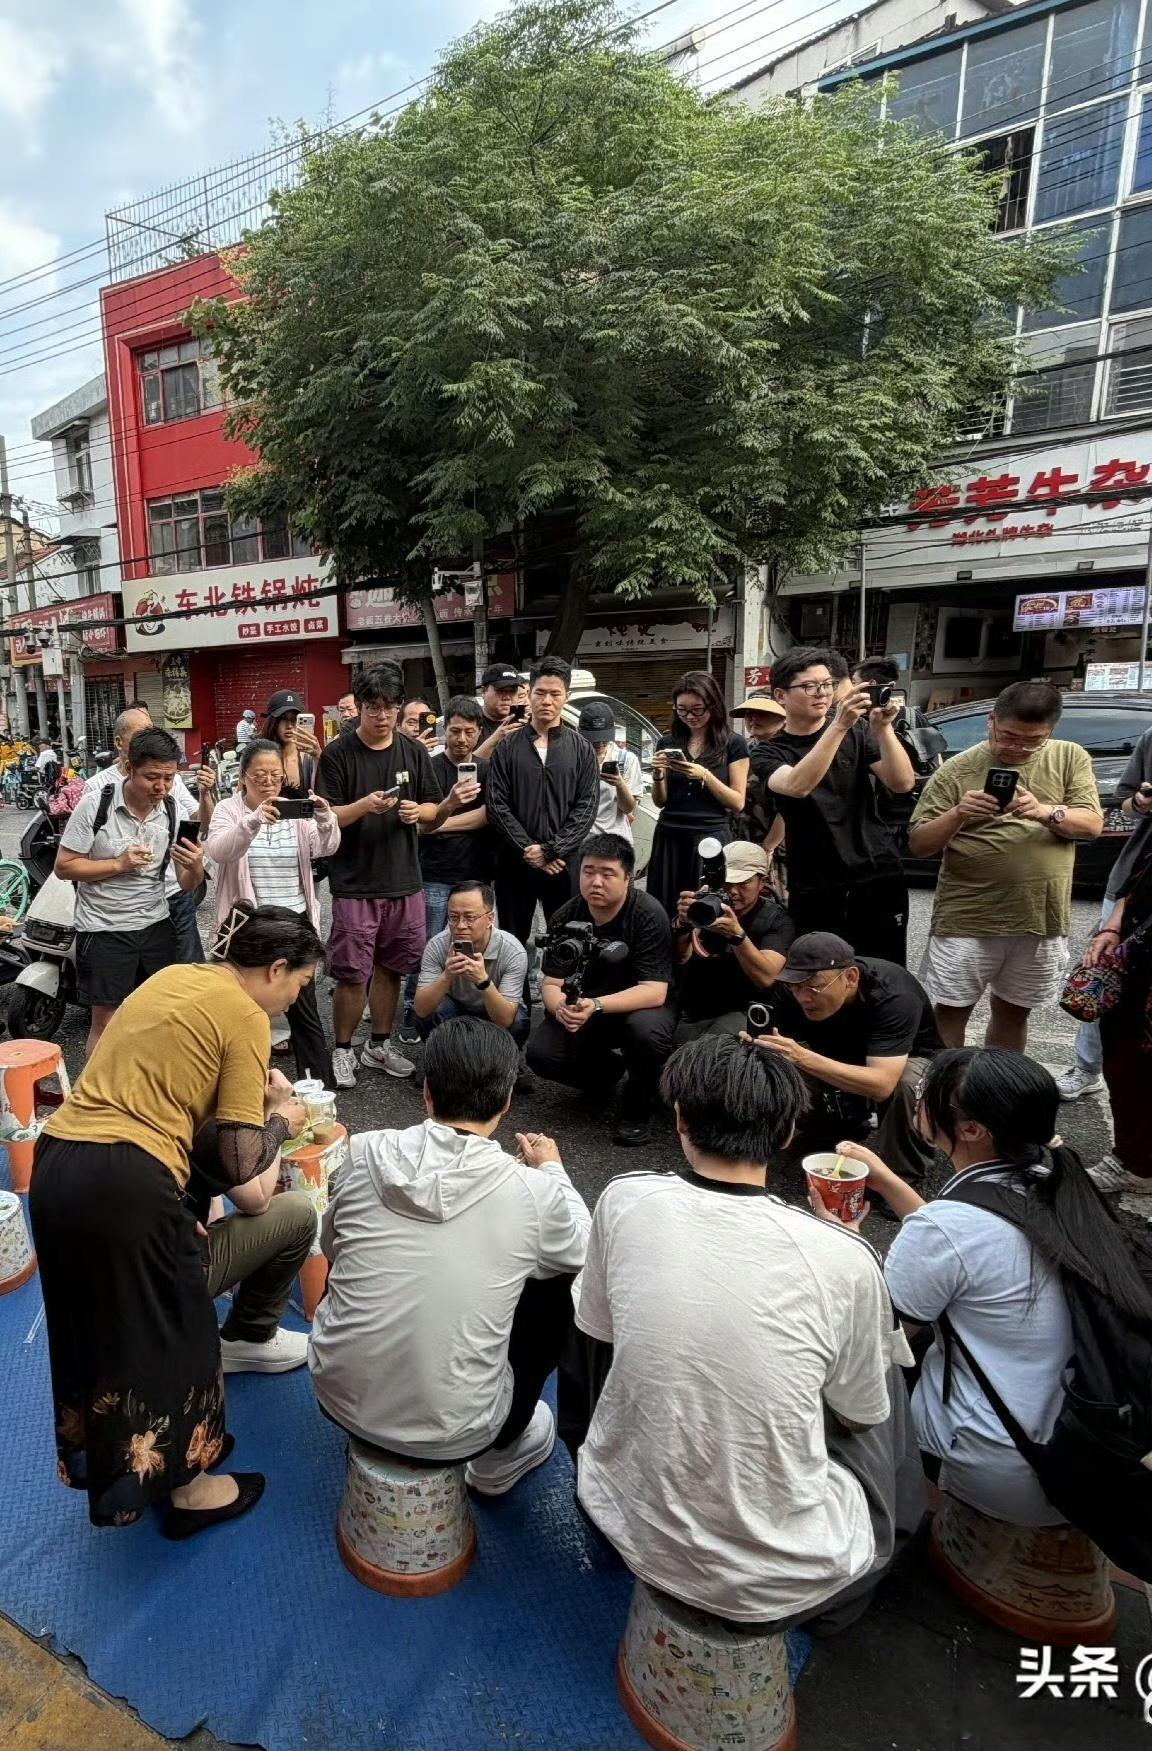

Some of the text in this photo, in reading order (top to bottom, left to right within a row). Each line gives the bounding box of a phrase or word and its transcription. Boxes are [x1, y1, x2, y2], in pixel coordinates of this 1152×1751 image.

[174, 573, 321, 621] 东北铁锅炖
[241, 626, 258, 636] 炒菜
[266, 622, 298, 634] 手工水饺
